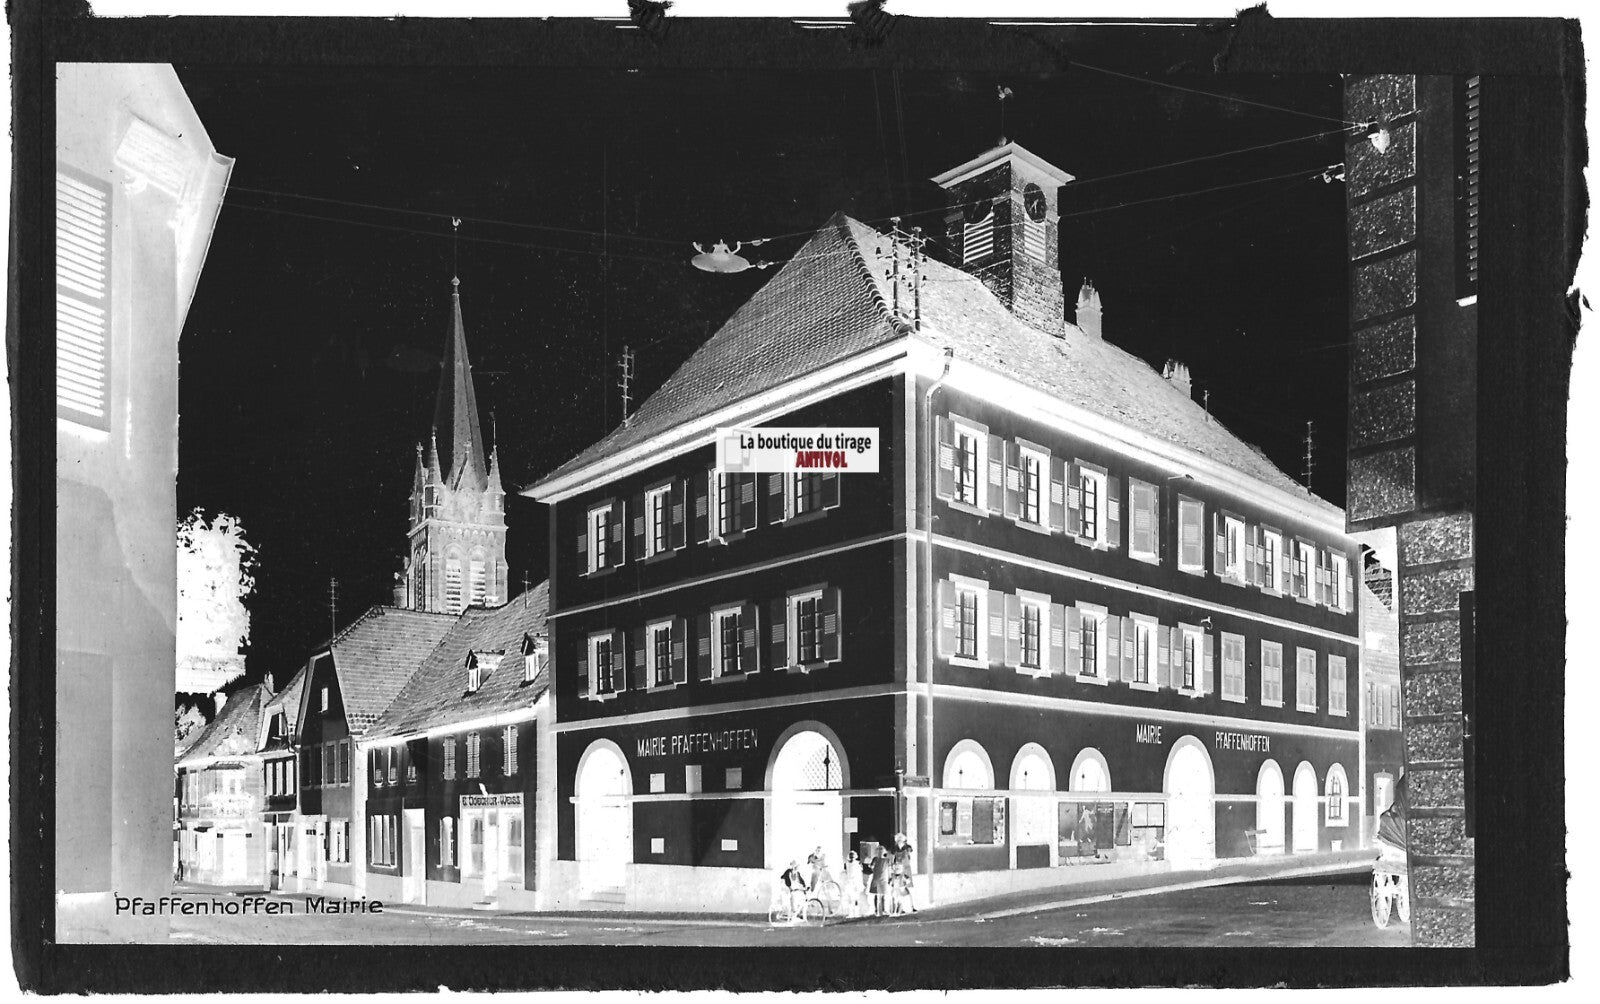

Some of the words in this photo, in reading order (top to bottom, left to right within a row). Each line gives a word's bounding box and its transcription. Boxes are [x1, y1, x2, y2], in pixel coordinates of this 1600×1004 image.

[637, 736, 667, 757] MAIRIE
[671, 728, 758, 755] PFAFFENHOFFEN
[1136, 724, 1162, 744] MAIRIE
[1215, 731, 1270, 752] PFAFFENHOFFEN
